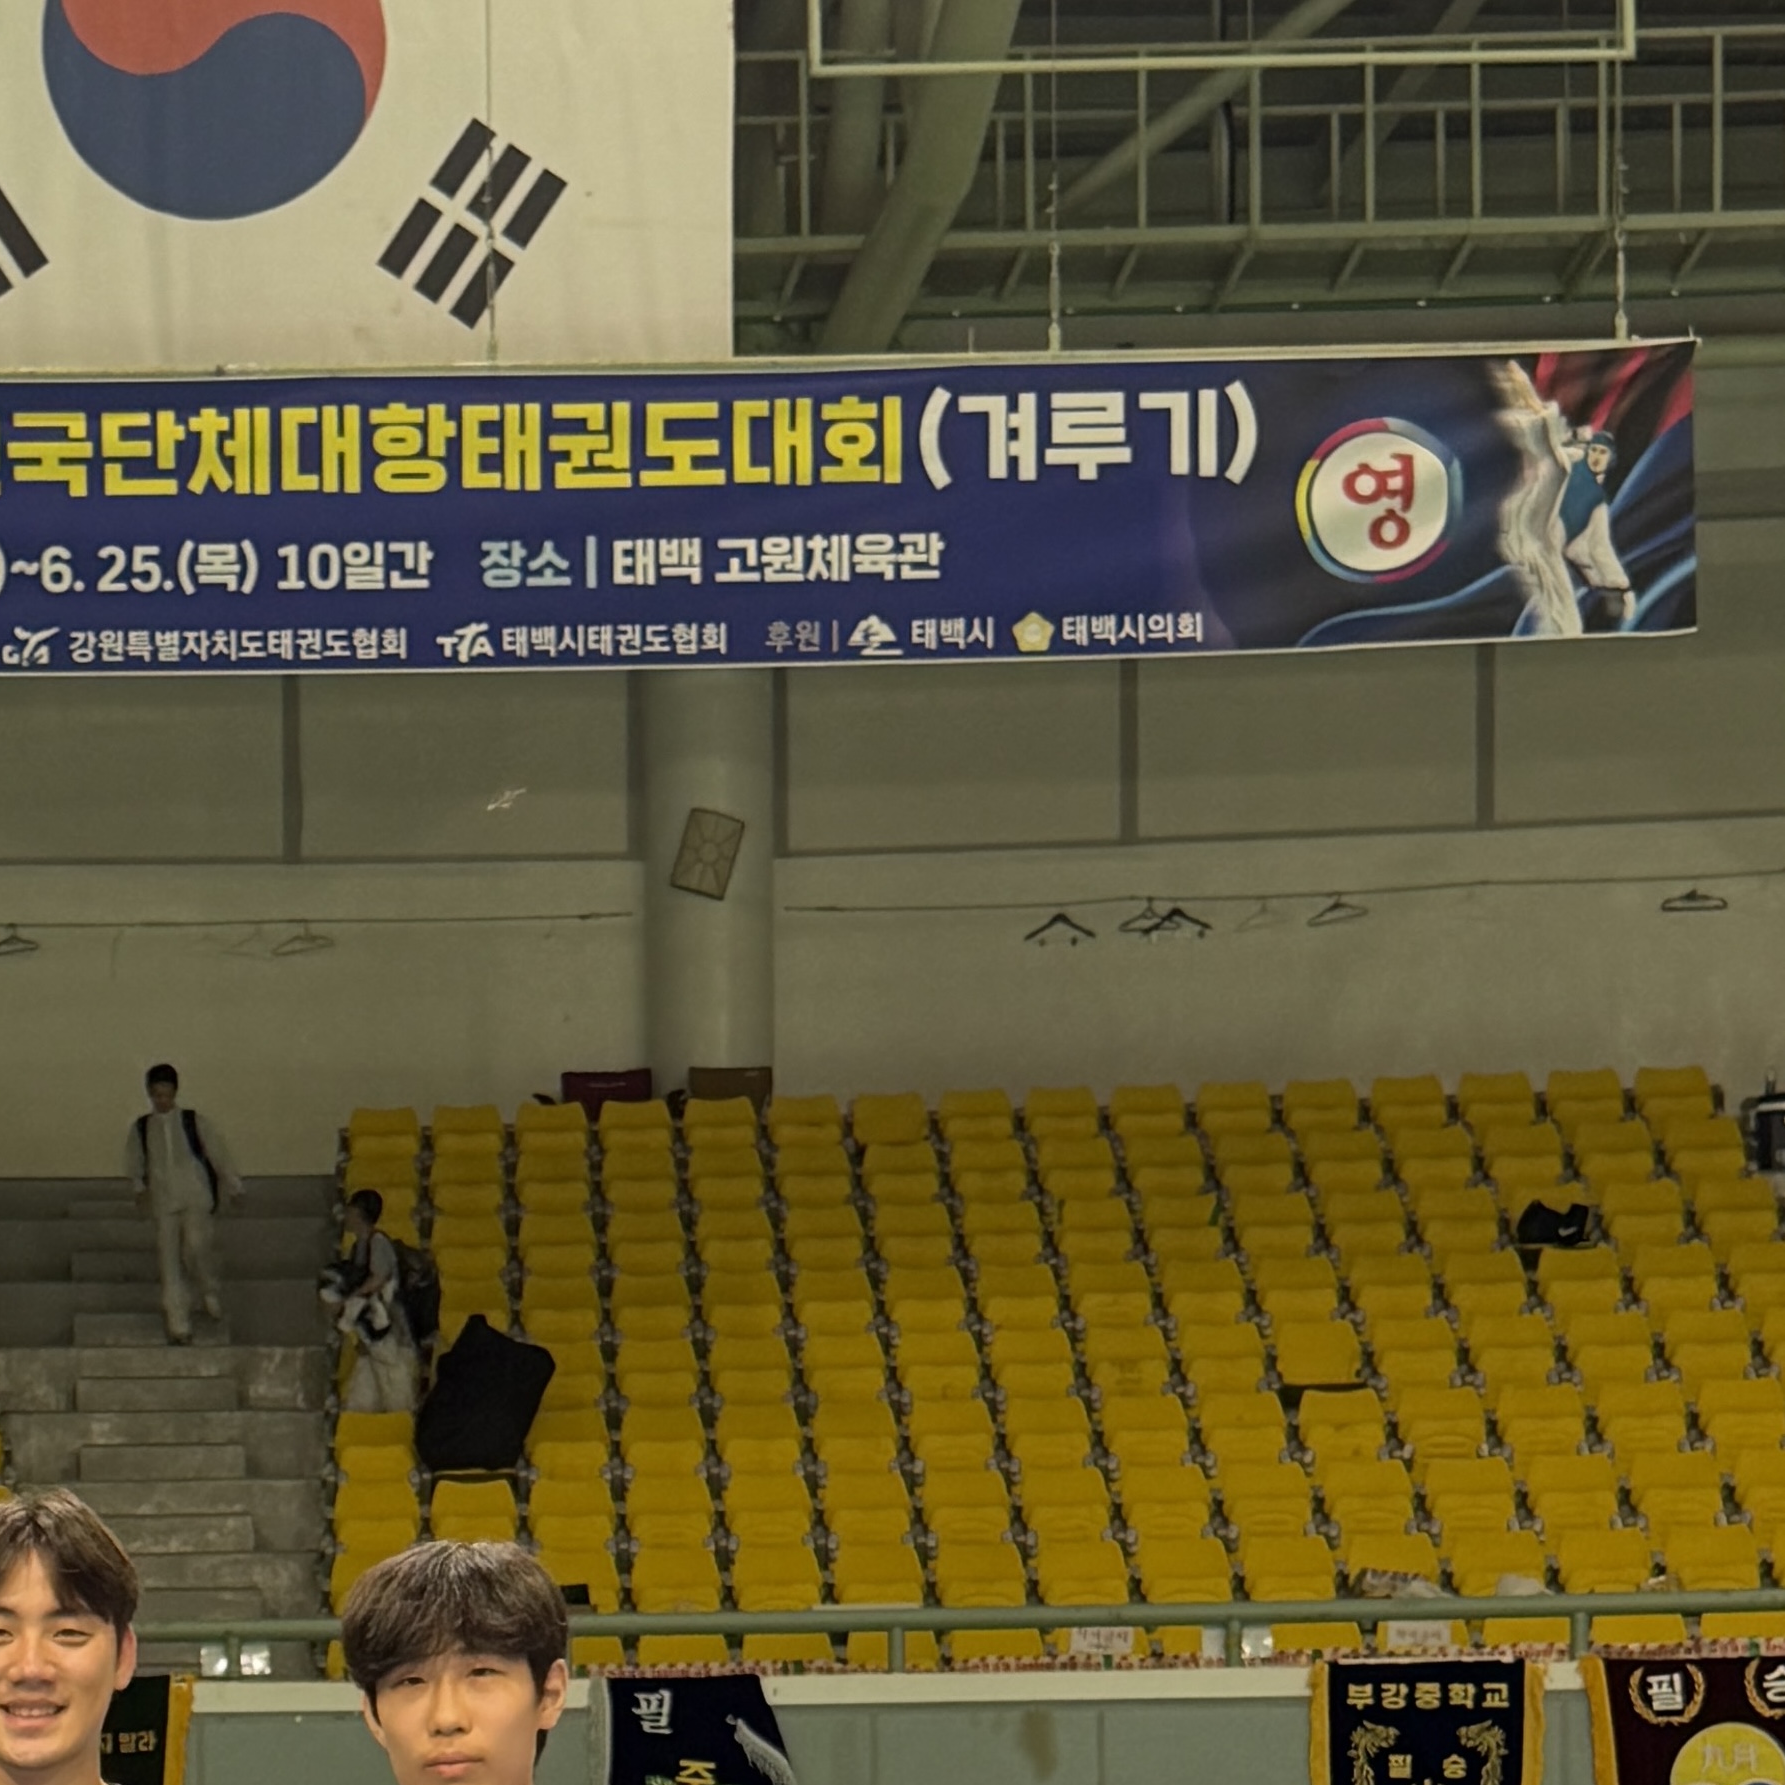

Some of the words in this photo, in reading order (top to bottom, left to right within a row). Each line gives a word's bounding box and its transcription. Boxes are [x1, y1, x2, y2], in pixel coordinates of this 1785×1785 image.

[1342, 452, 1417, 552] 영
[97, 540, 259, 596] 25.(목)
[277, 541, 434, 591] 10일간
[479, 537, 572, 588] 장소
[613, 536, 703, 586] 태백
[714, 532, 945, 585] 고원체육관
[69, 627, 408, 664] 강원특별자치도태권도협회
[501, 622, 728, 657] 태백시태권도협회
[764, 621, 821, 653] 후원
[910, 615, 995, 650] 태백시
[1061, 612, 1204, 649] 태백시의회
[632, 1688, 673, 1735] 필
[1347, 1682, 1510, 1710] 부강중학교
[1646, 1673, 1685, 1713] 필
[1388, 1753, 1413, 1779] 필
[1442, 1753, 1468, 1779] 승
